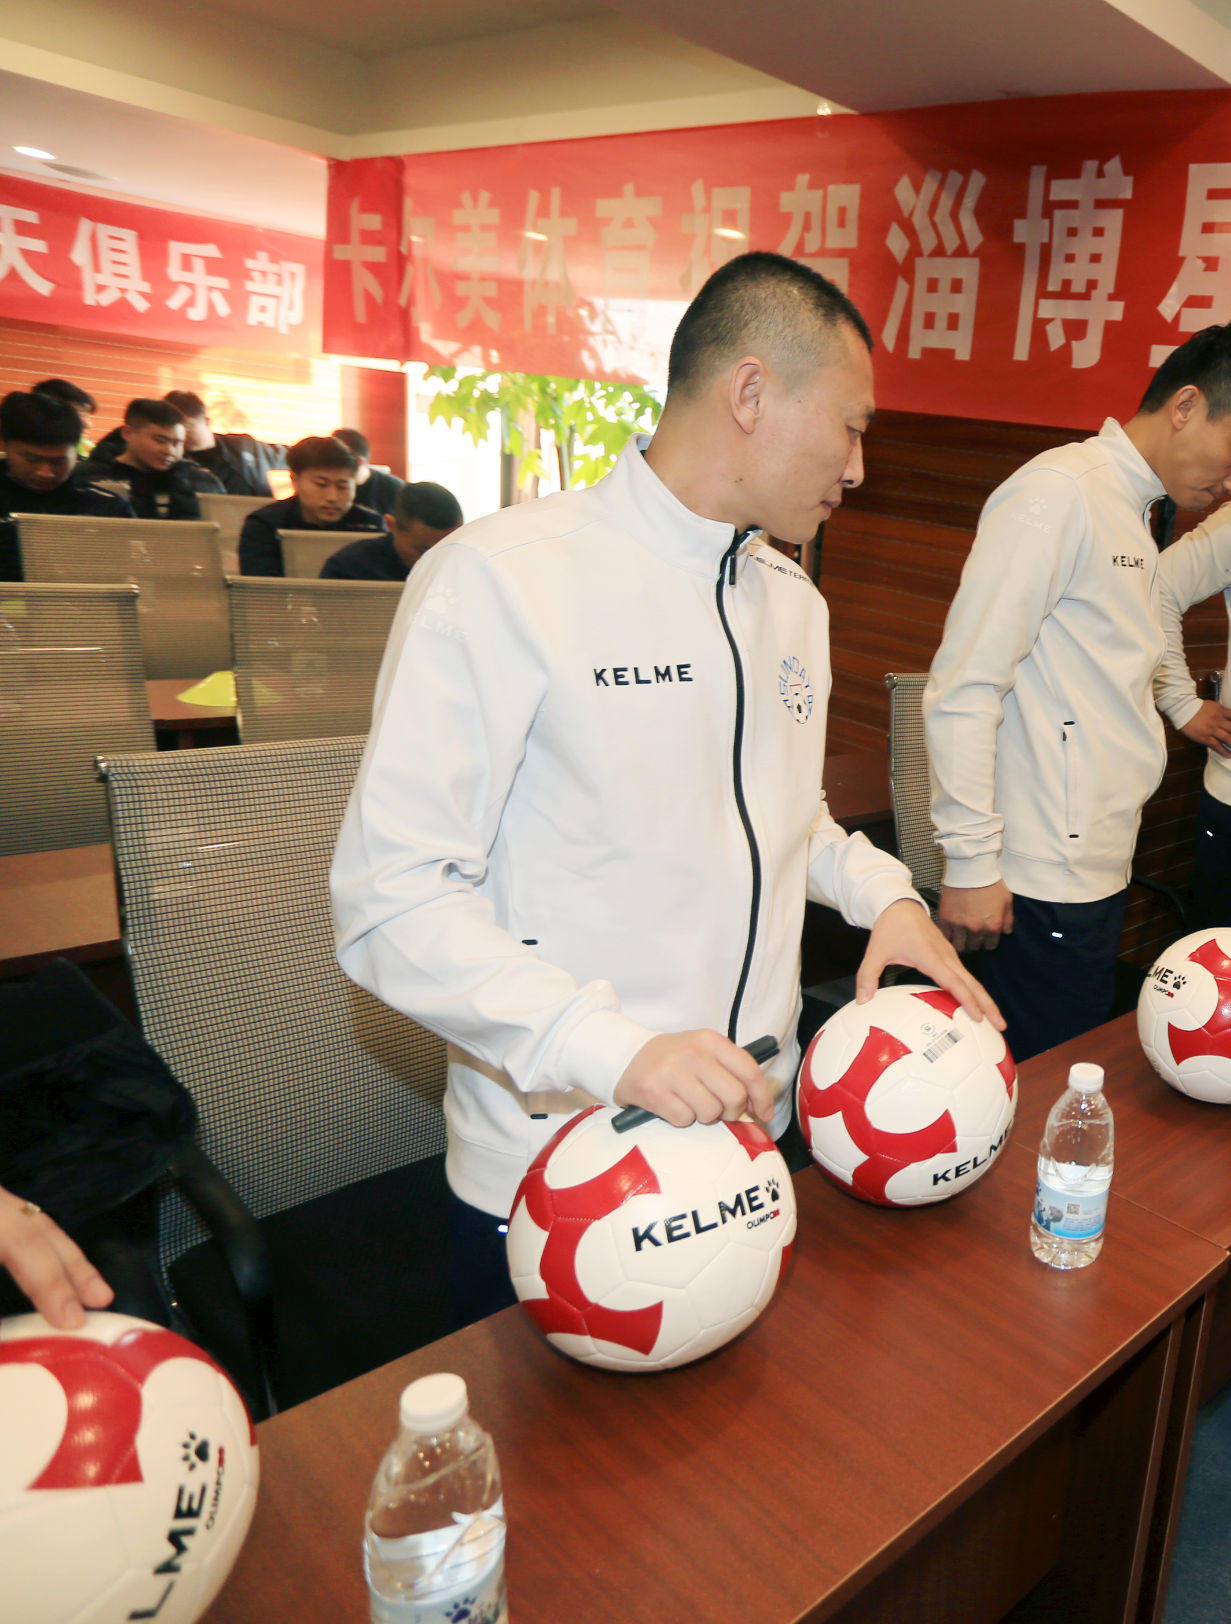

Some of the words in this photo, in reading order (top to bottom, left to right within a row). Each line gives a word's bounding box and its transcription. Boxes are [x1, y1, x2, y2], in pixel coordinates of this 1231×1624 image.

[1112, 555, 1146, 571] KELME
[593, 664, 694, 687] KELME
[632, 1185, 765, 1252] KELME
